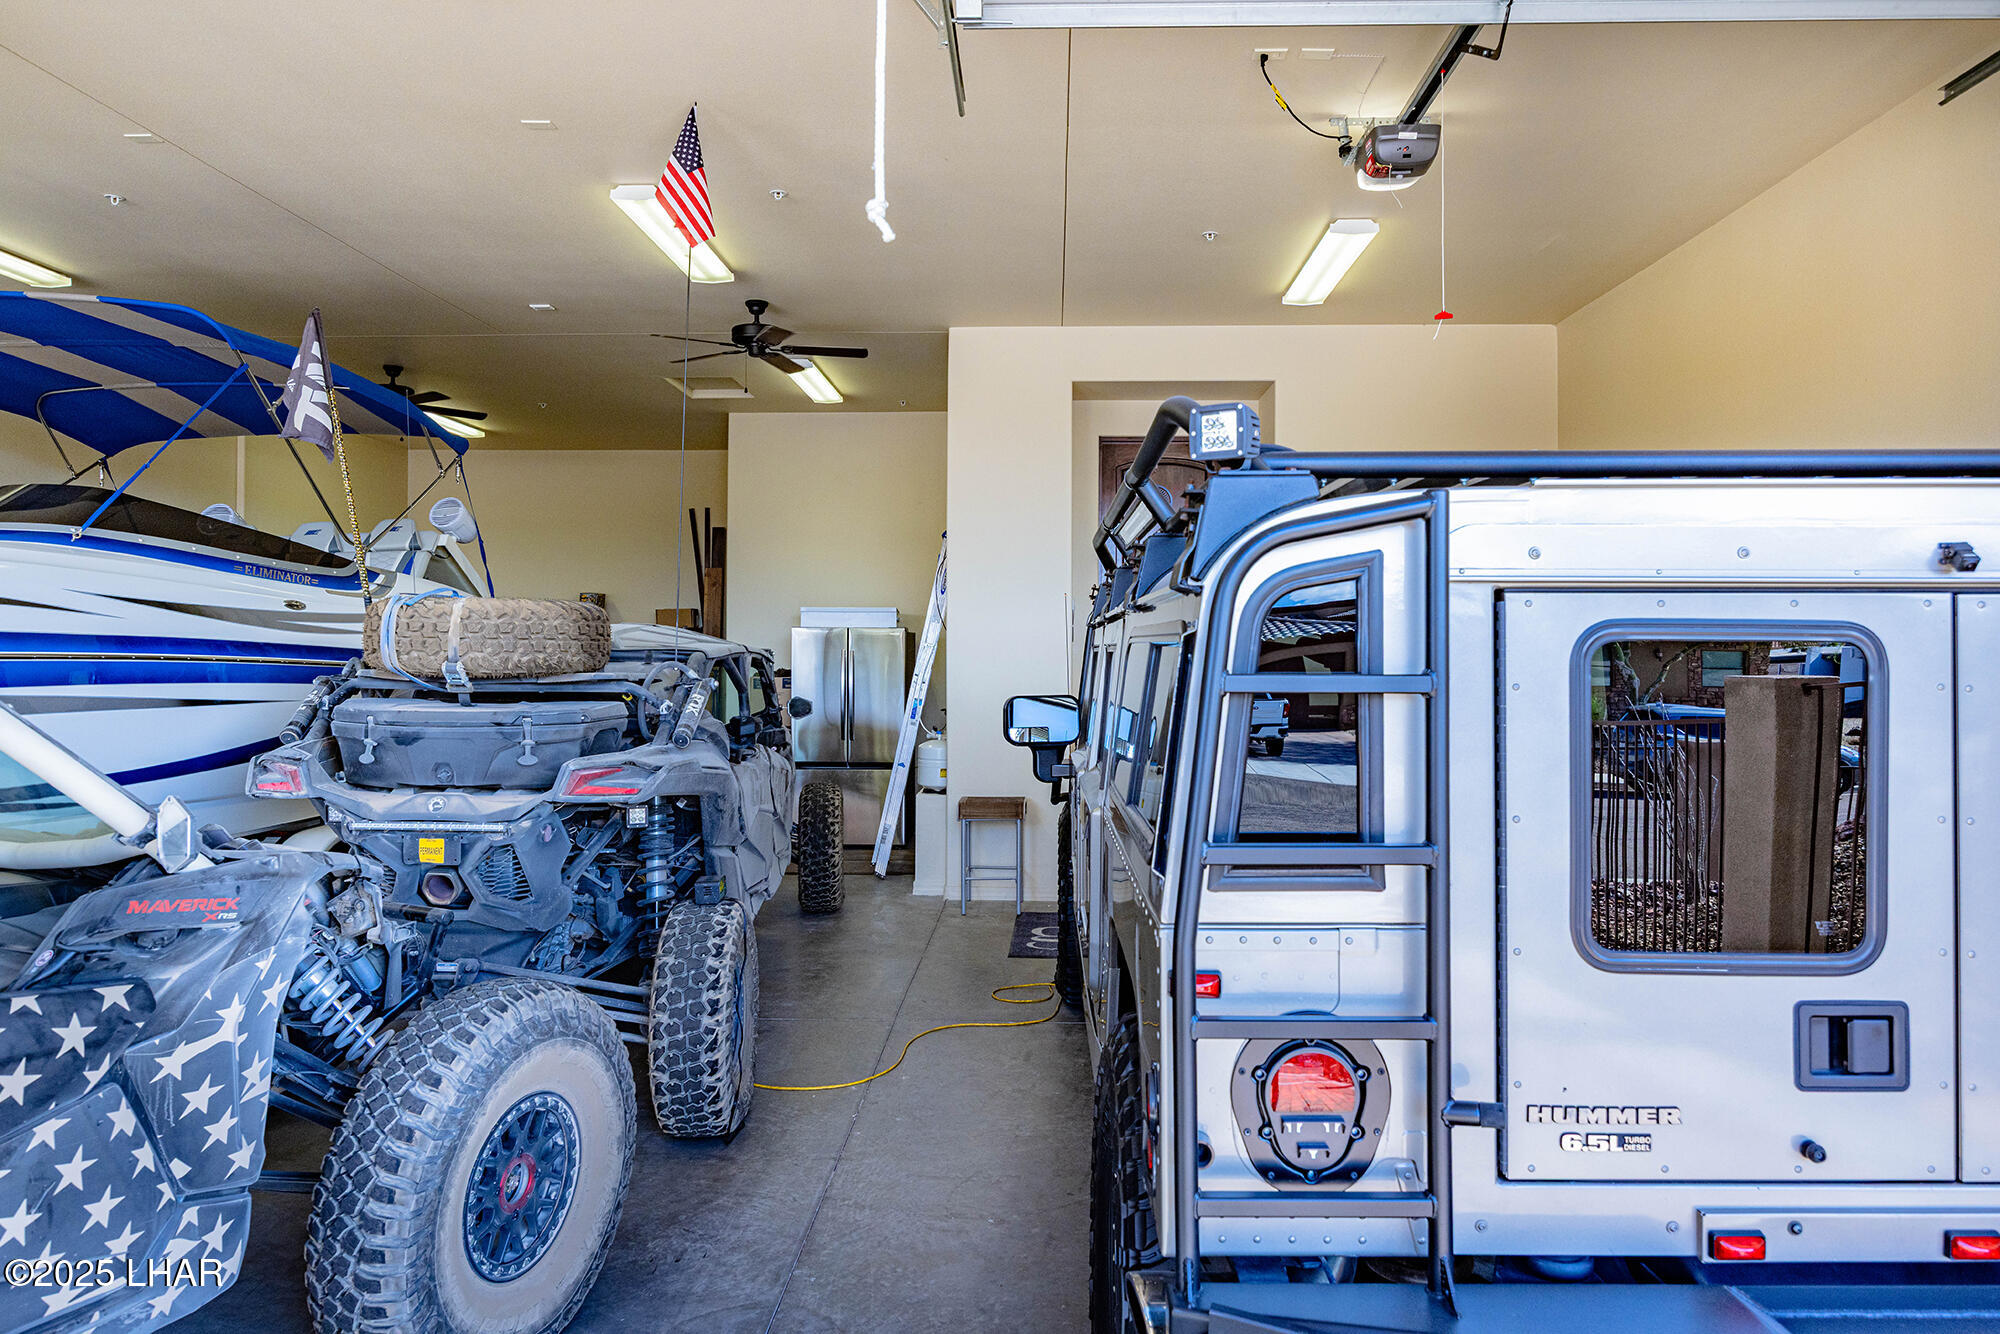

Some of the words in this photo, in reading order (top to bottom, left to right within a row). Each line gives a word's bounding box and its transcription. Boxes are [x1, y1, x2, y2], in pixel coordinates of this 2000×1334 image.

[244, 564, 311, 584] ELIMINATOR
[420, 846, 443, 855] PERMANENT
[126, 897, 240, 914] MAVERICK
[1526, 1104, 1682, 1125] HUMMER
[1560, 1132, 1624, 1152] 6.5L
[1624, 1136, 1651, 1144] TURBO
[1624, 1144, 1651, 1152] DIESEL
